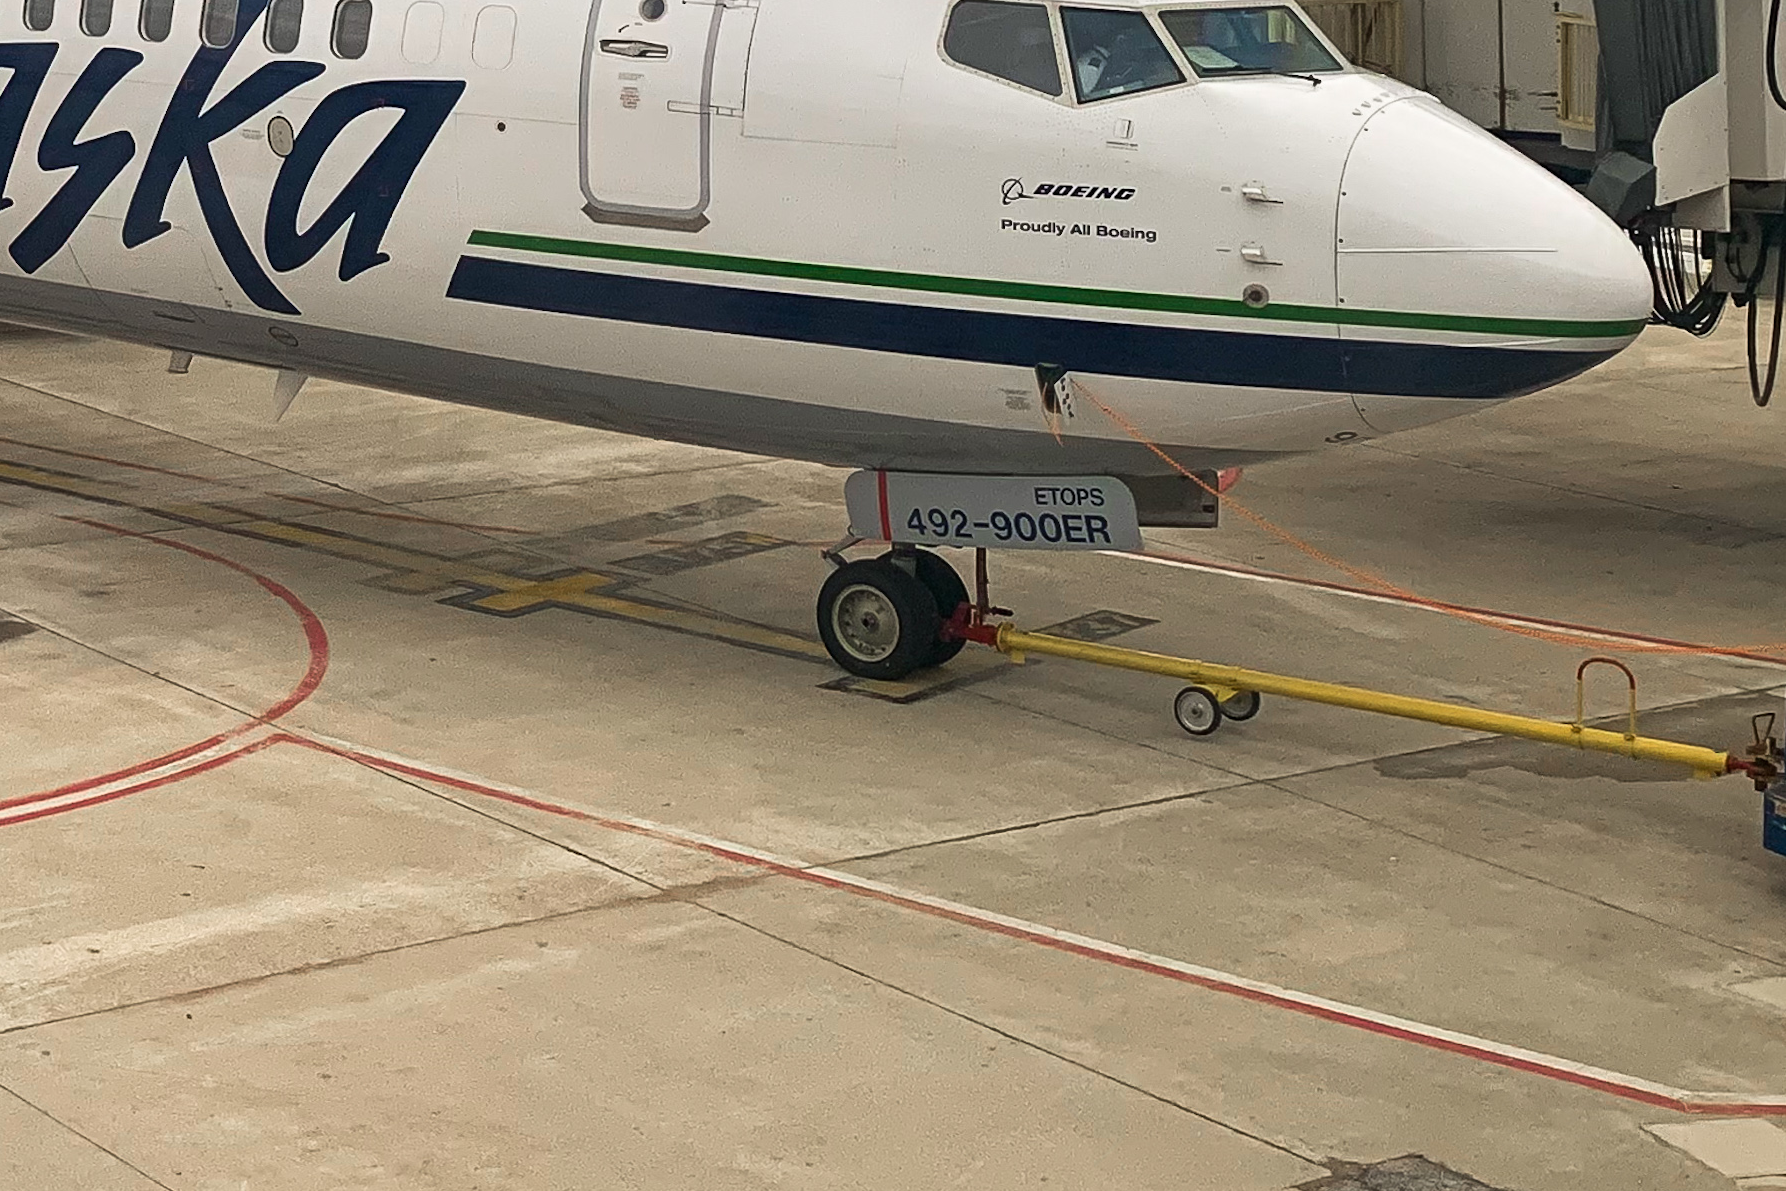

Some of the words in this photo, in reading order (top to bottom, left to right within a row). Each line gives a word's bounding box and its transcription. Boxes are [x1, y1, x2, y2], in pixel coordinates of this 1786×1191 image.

[1033, 183, 1136, 200] BOEING
[1001, 219, 1065, 236] Proudly
[1070, 224, 1091, 236] All
[1096, 225, 1157, 243] Boeing
[1033, 486, 1105, 507] ETOPS
[907, 508, 1111, 544] 492-900ER
